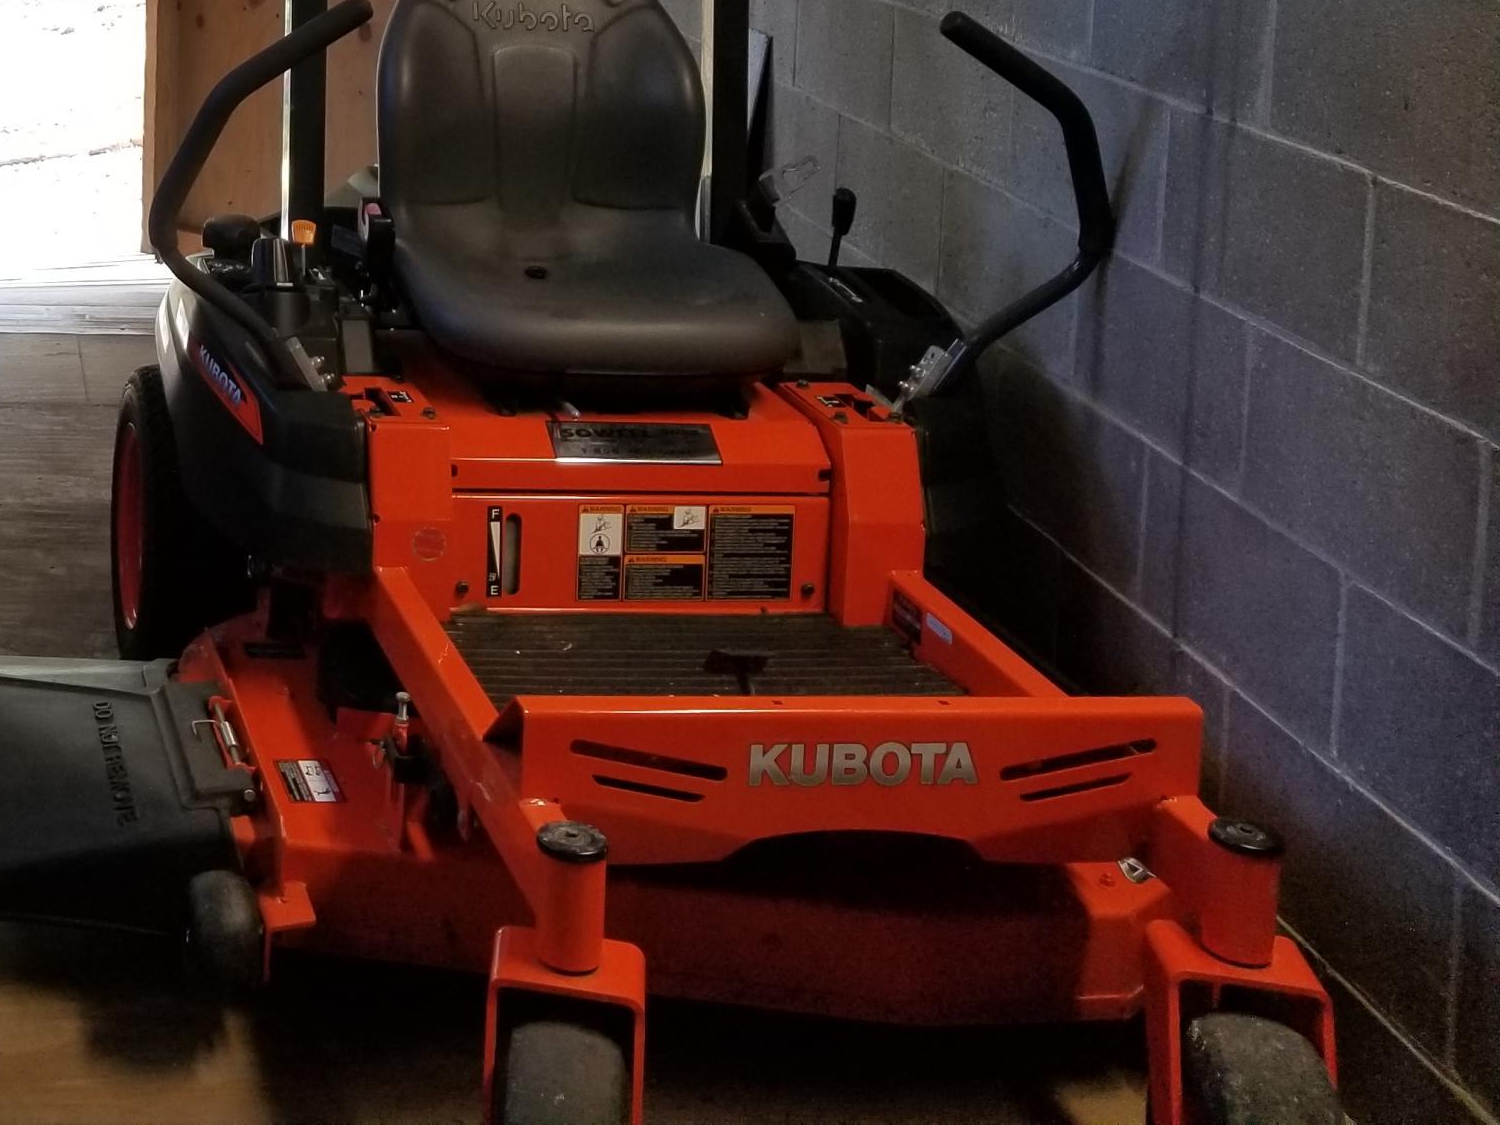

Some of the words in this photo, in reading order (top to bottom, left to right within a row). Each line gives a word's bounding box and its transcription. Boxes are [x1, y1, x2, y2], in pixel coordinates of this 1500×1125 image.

[472, 2, 594, 31] Kubota
[199, 344, 242, 405] KUBOTA
[491, 508, 500, 520] F
[490, 585, 499, 596] E
[748, 741, 980, 787] KUBOTA
